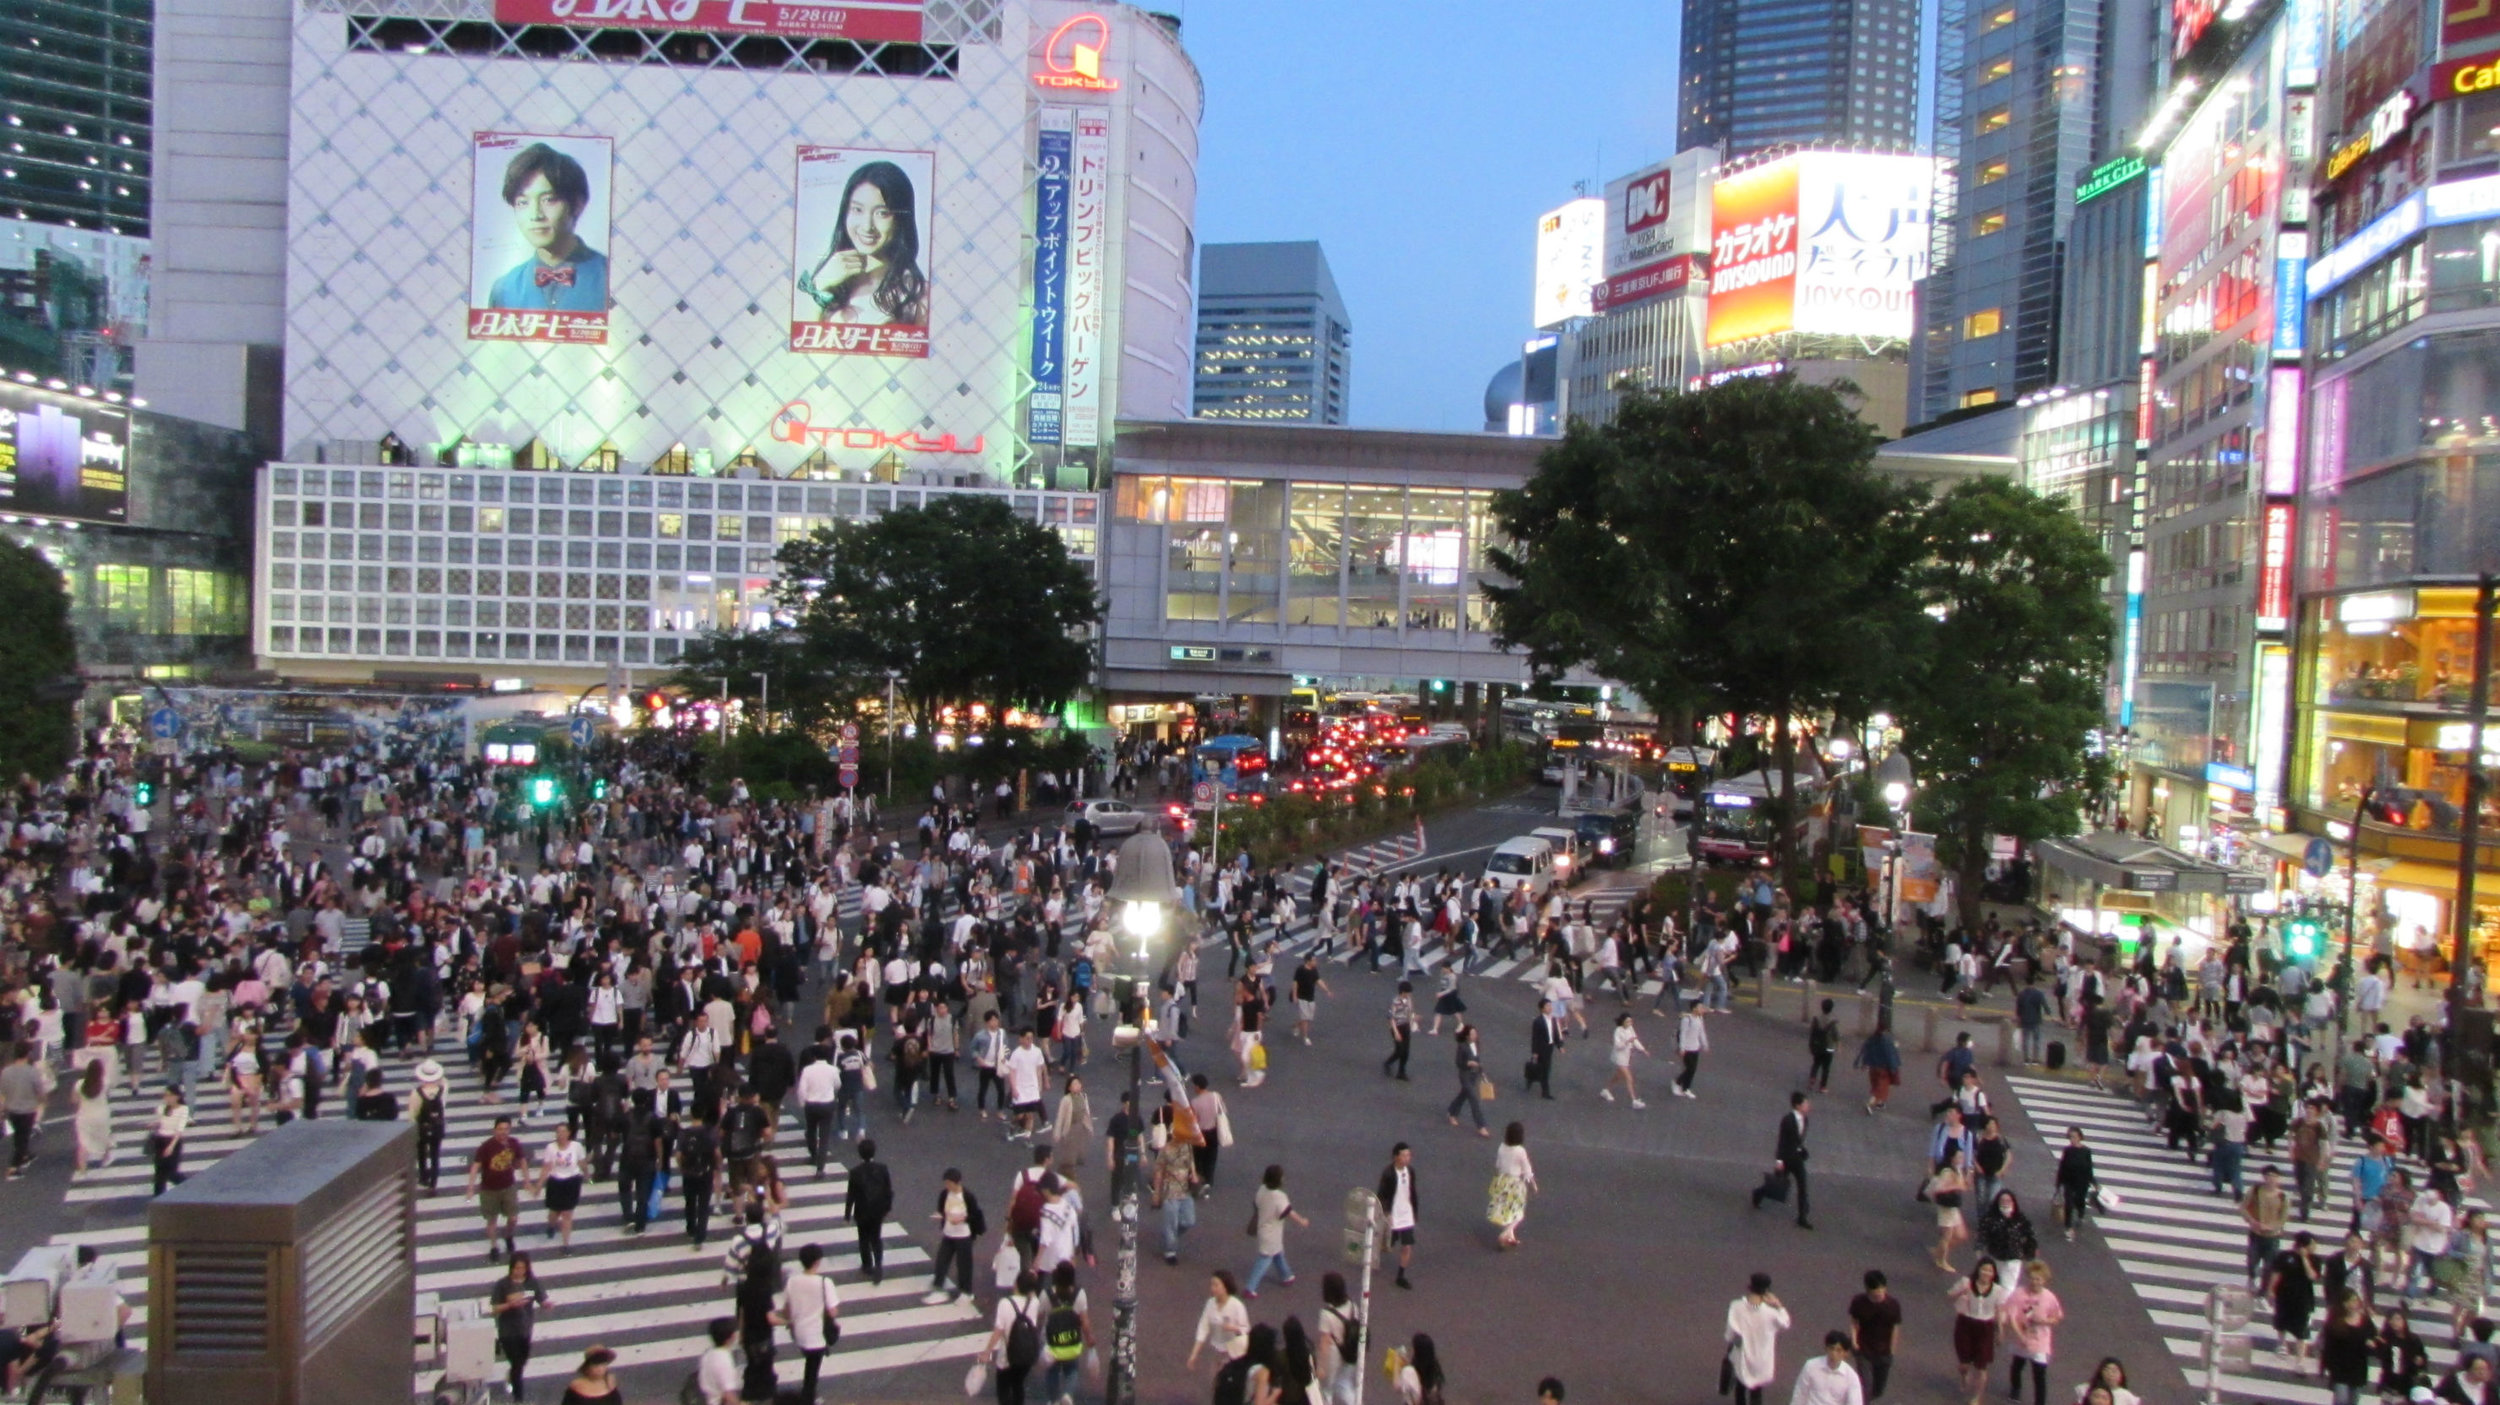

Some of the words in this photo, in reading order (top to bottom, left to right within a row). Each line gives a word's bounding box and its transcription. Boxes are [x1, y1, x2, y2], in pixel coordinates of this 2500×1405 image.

[1034, 75, 1119, 90] TOKYU
[2112, 157, 2144, 181] CITY
[1627, 176, 1666, 227] DC
[1629, 237, 1675, 260] MasterCard
[1714, 213, 1795, 268] カラオケ
[1071, 156, 1096, 399] トリンプビッグバーゲン
[1614, 265, 1682, 298] 三菱東京UFJ銀行
[1712, 252, 1795, 295] JOYSOUND
[806, 427, 984, 454] TOKYU
